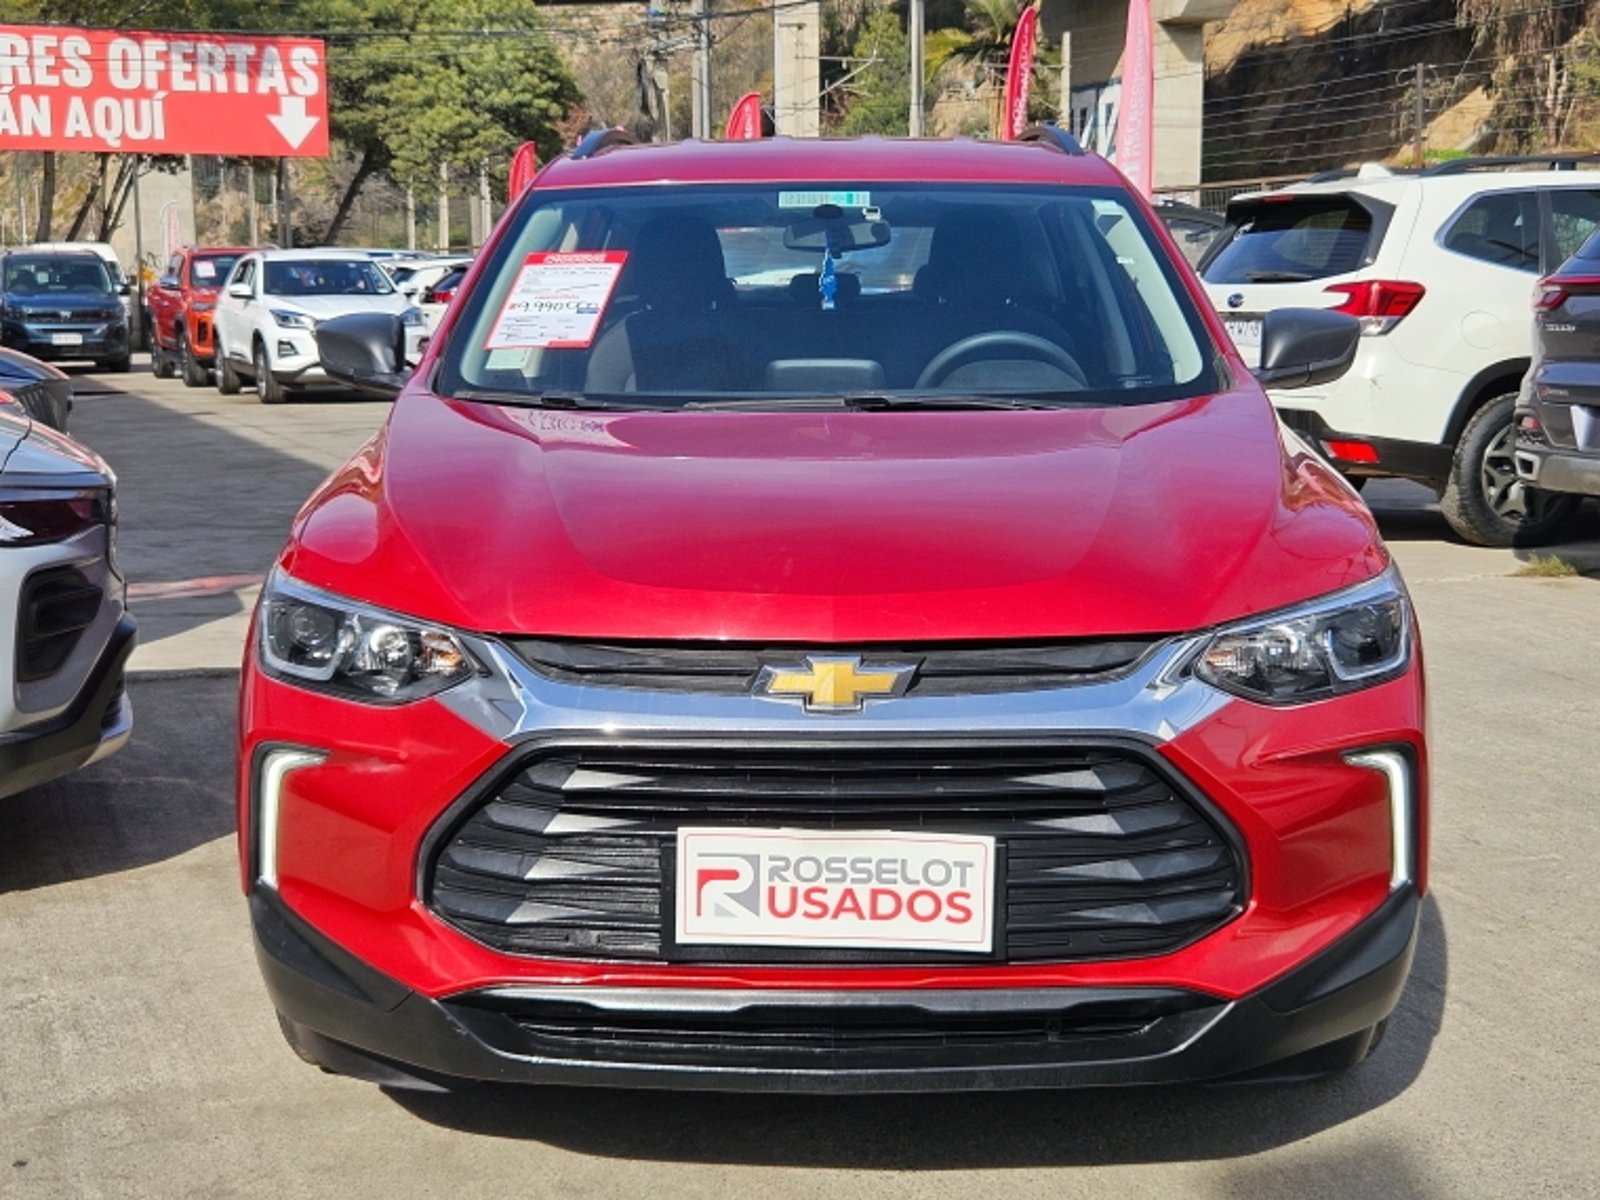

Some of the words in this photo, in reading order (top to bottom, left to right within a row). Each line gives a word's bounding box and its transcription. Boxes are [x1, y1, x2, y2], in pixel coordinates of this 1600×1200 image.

[0, 32, 93, 88] RES
[108, 37, 319, 96] OFERTAS
[0, 86, 52, 137] ÁN
[64, 90, 169, 148] AQUÍ
[768, 854, 974, 888] ROSSELOT
[768, 886, 973, 925] USADOS
